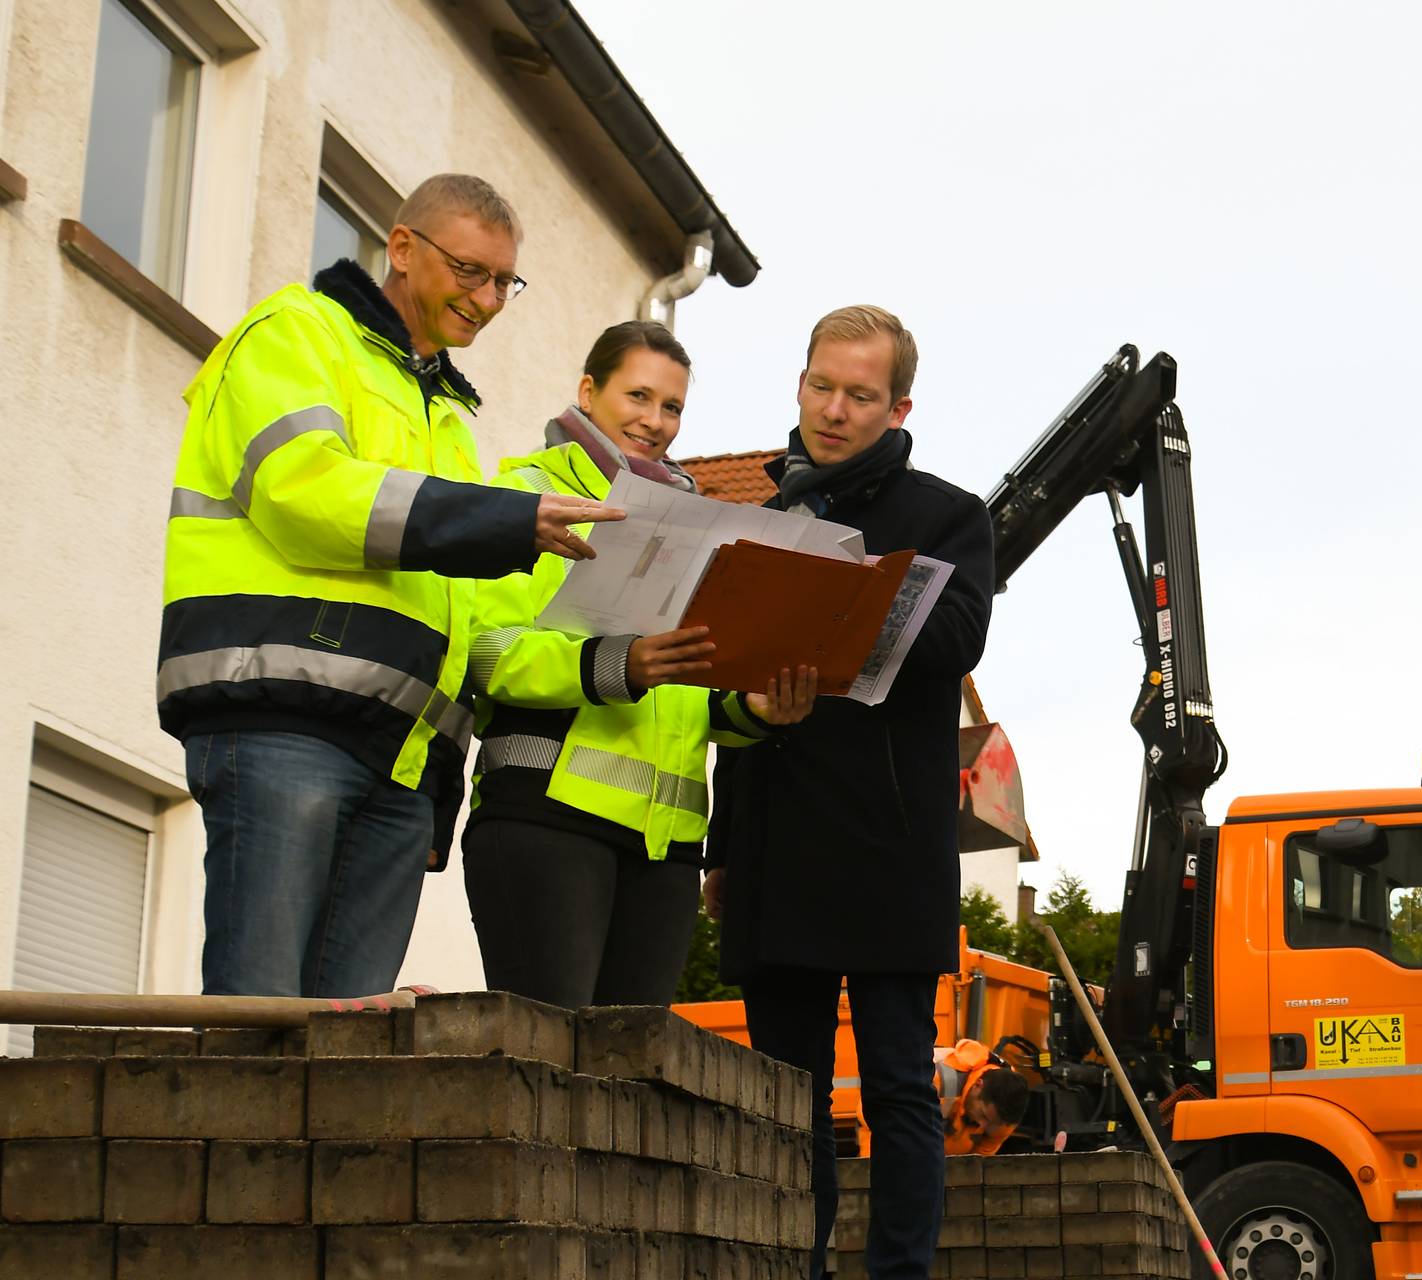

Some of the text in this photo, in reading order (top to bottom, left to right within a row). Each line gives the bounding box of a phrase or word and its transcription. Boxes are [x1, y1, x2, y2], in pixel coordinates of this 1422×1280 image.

[1160, 644, 1177, 729] X-HIDUO 092
[1391, 1017, 1401, 1043] BAU
